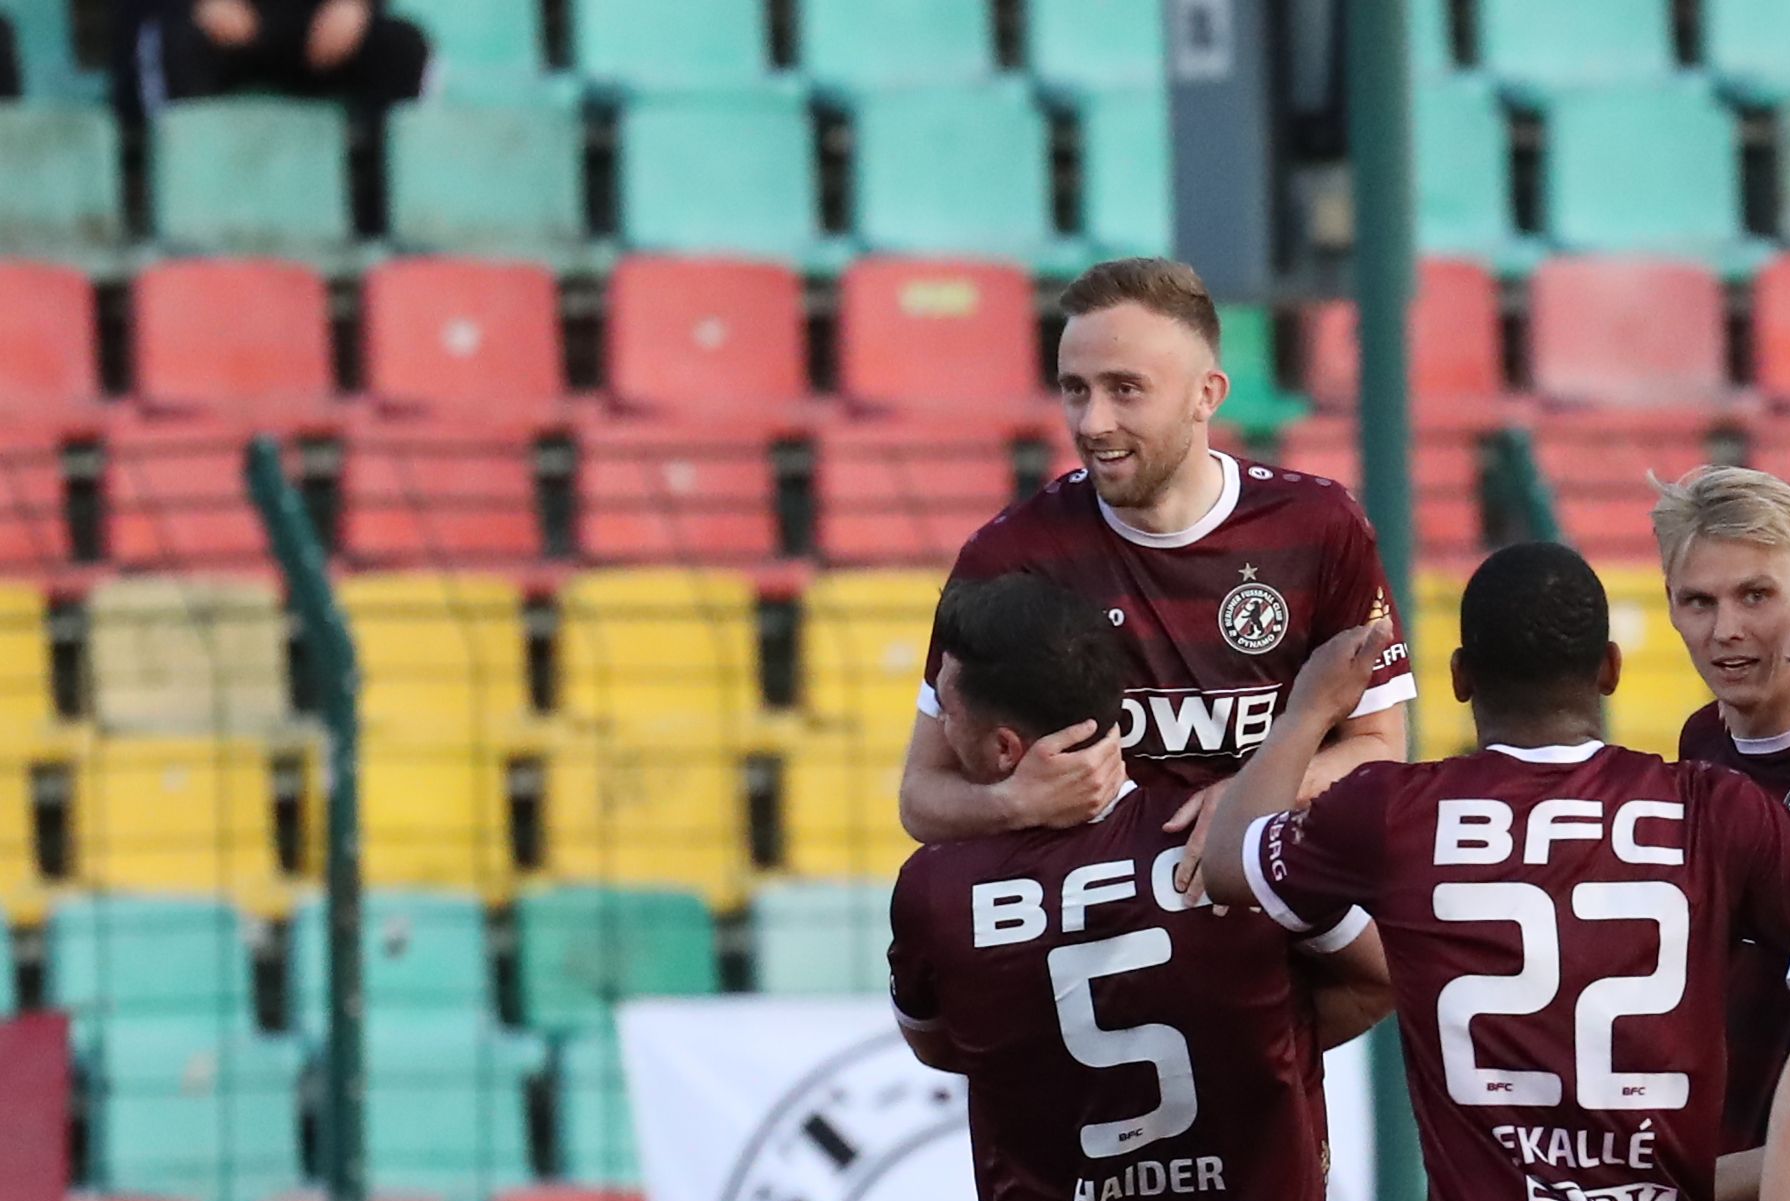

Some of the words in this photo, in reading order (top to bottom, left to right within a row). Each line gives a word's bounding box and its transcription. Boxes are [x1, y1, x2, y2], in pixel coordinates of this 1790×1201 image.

[1433, 799, 1684, 865] BFC
[1433, 881, 1690, 1110] 22
[1047, 927, 1198, 1158] 5
[1486, 1082, 1513, 1093] BFC
[1622, 1086, 1646, 1097] BFC
[1119, 1128, 1144, 1142] BFC
